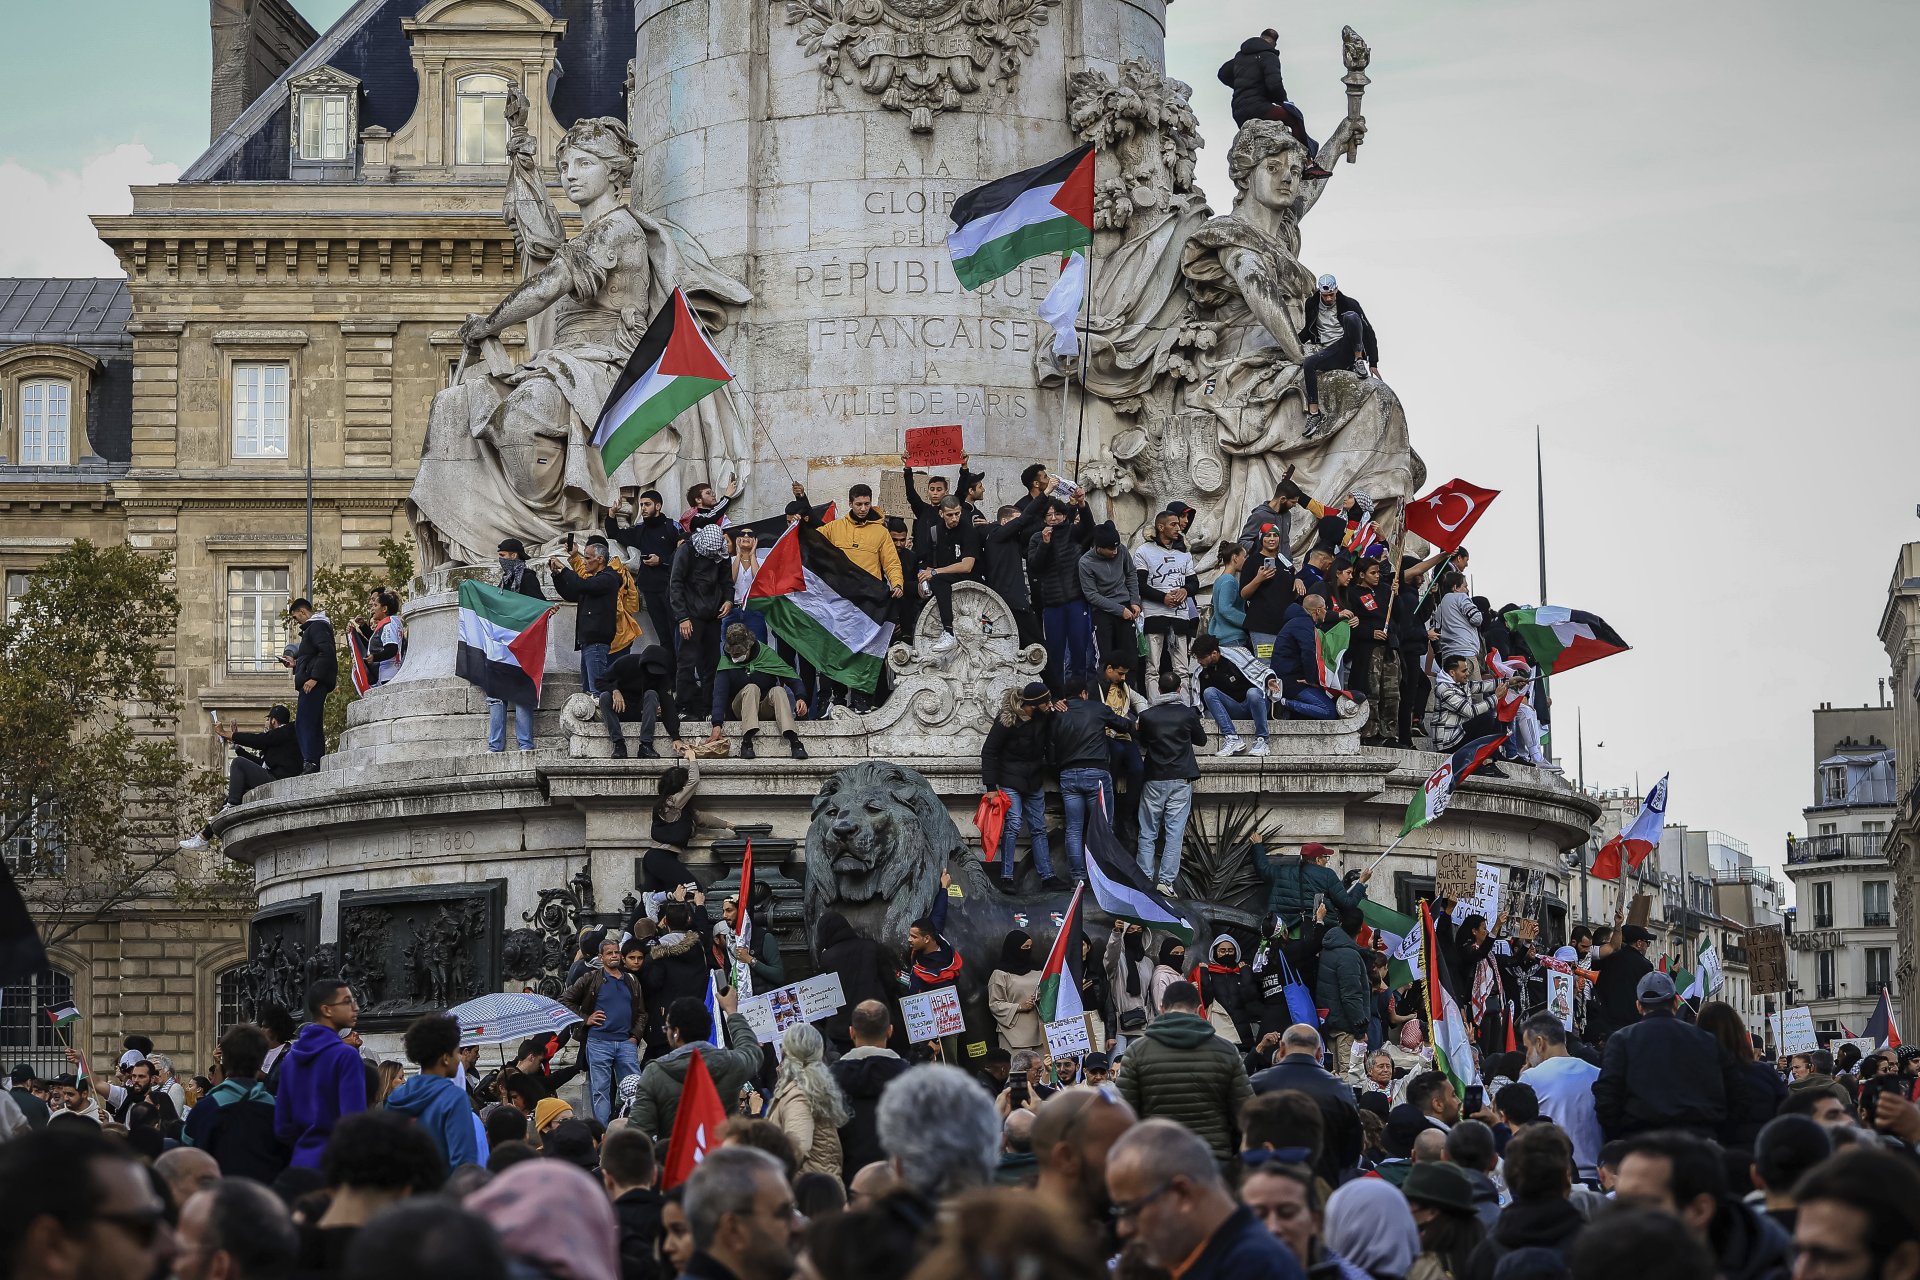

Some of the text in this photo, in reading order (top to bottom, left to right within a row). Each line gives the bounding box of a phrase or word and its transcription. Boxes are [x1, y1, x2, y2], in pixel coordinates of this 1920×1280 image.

[894, 159, 951, 175] A LA
[865, 191, 956, 214] GLOIR
[893, 230, 919, 244] DE
[817, 317, 1029, 353] FRANÇAISE
[910, 361, 941, 379] LA
[822, 392, 1027, 418] VILLE DE PARIS
[907, 427, 947, 440] ISRAEL
[929, 437, 952, 448] 1030
[438, 830, 475, 852] 1880
[1426, 826, 1443, 845] 20
[1441, 853, 1477, 868] CRIME
[1438, 869, 1467, 880] GUERRE
[1487, 884, 1495, 897] LE
[1457, 907, 1464, 919] DE
[1790, 931, 1846, 951] BRISTOL
[1054, 1050, 1084, 1061] SITUATION
